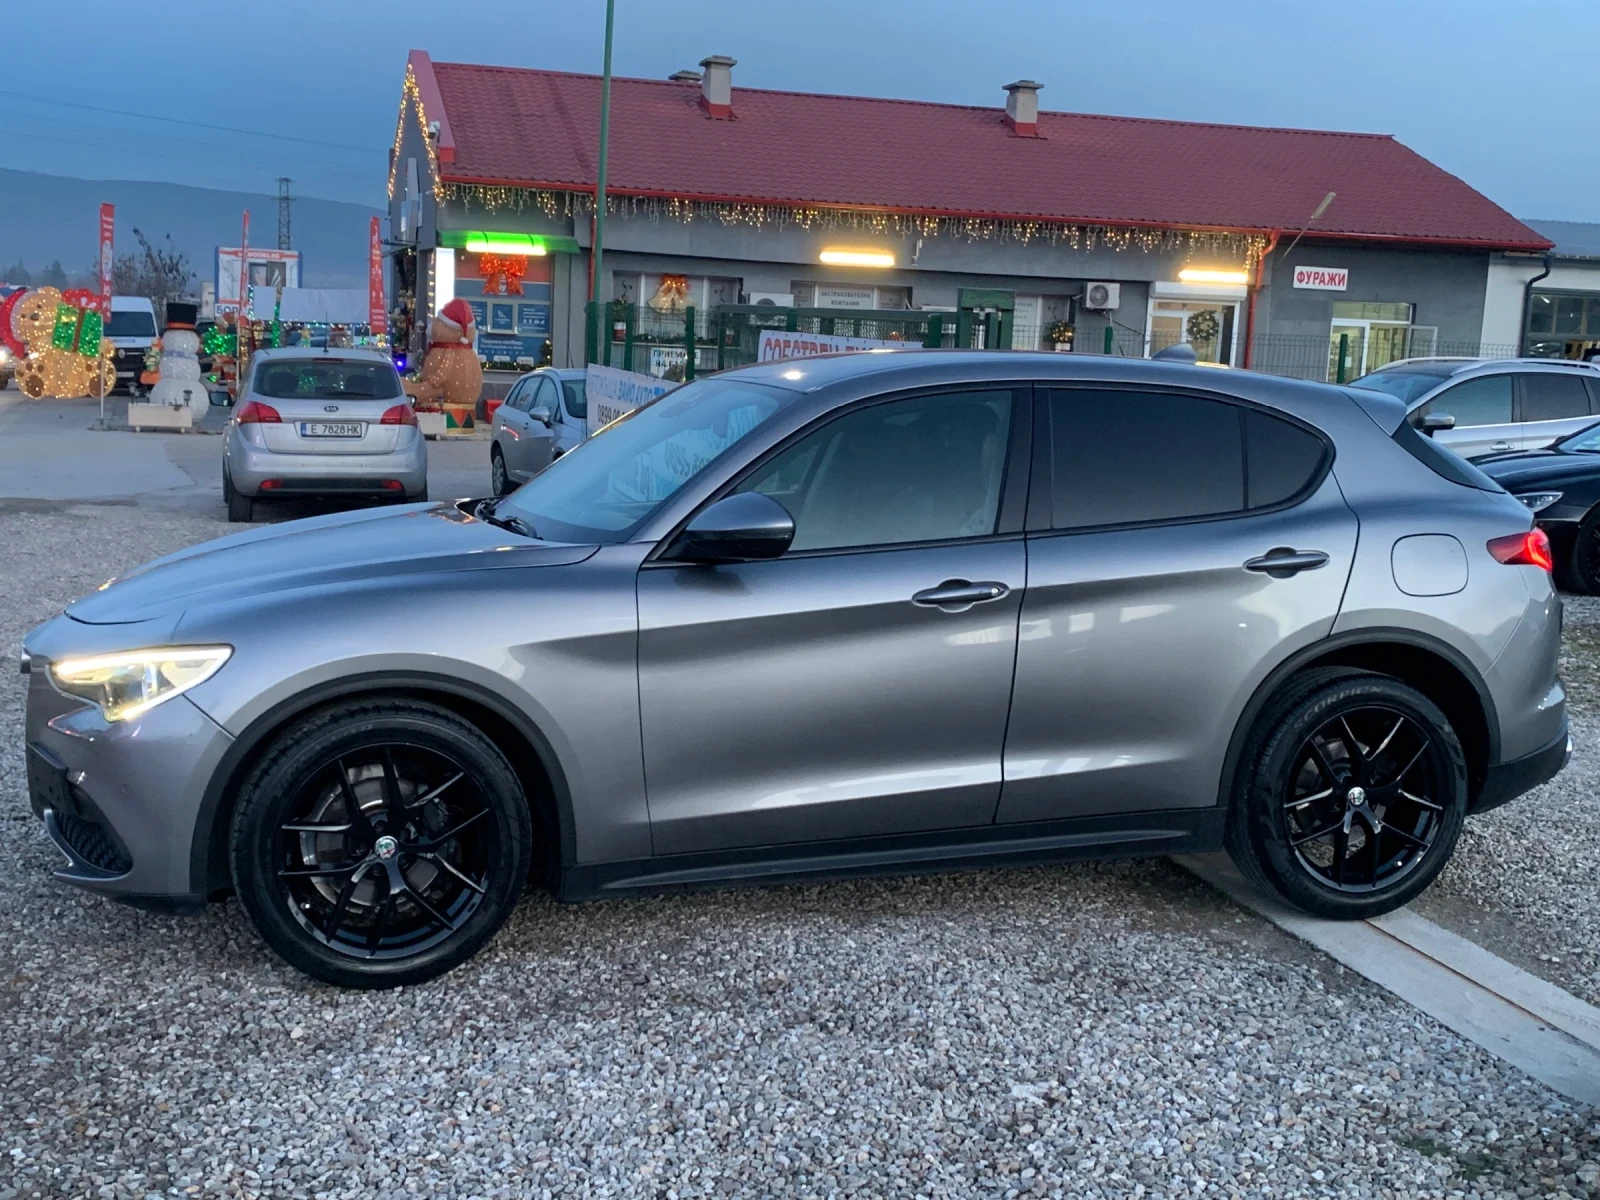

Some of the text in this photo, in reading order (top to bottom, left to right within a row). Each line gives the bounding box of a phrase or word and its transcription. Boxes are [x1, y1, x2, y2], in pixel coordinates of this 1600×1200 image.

[1296, 270, 1346, 286] ФУРАЖИ
[311, 425, 360, 434] E 7828 HK
